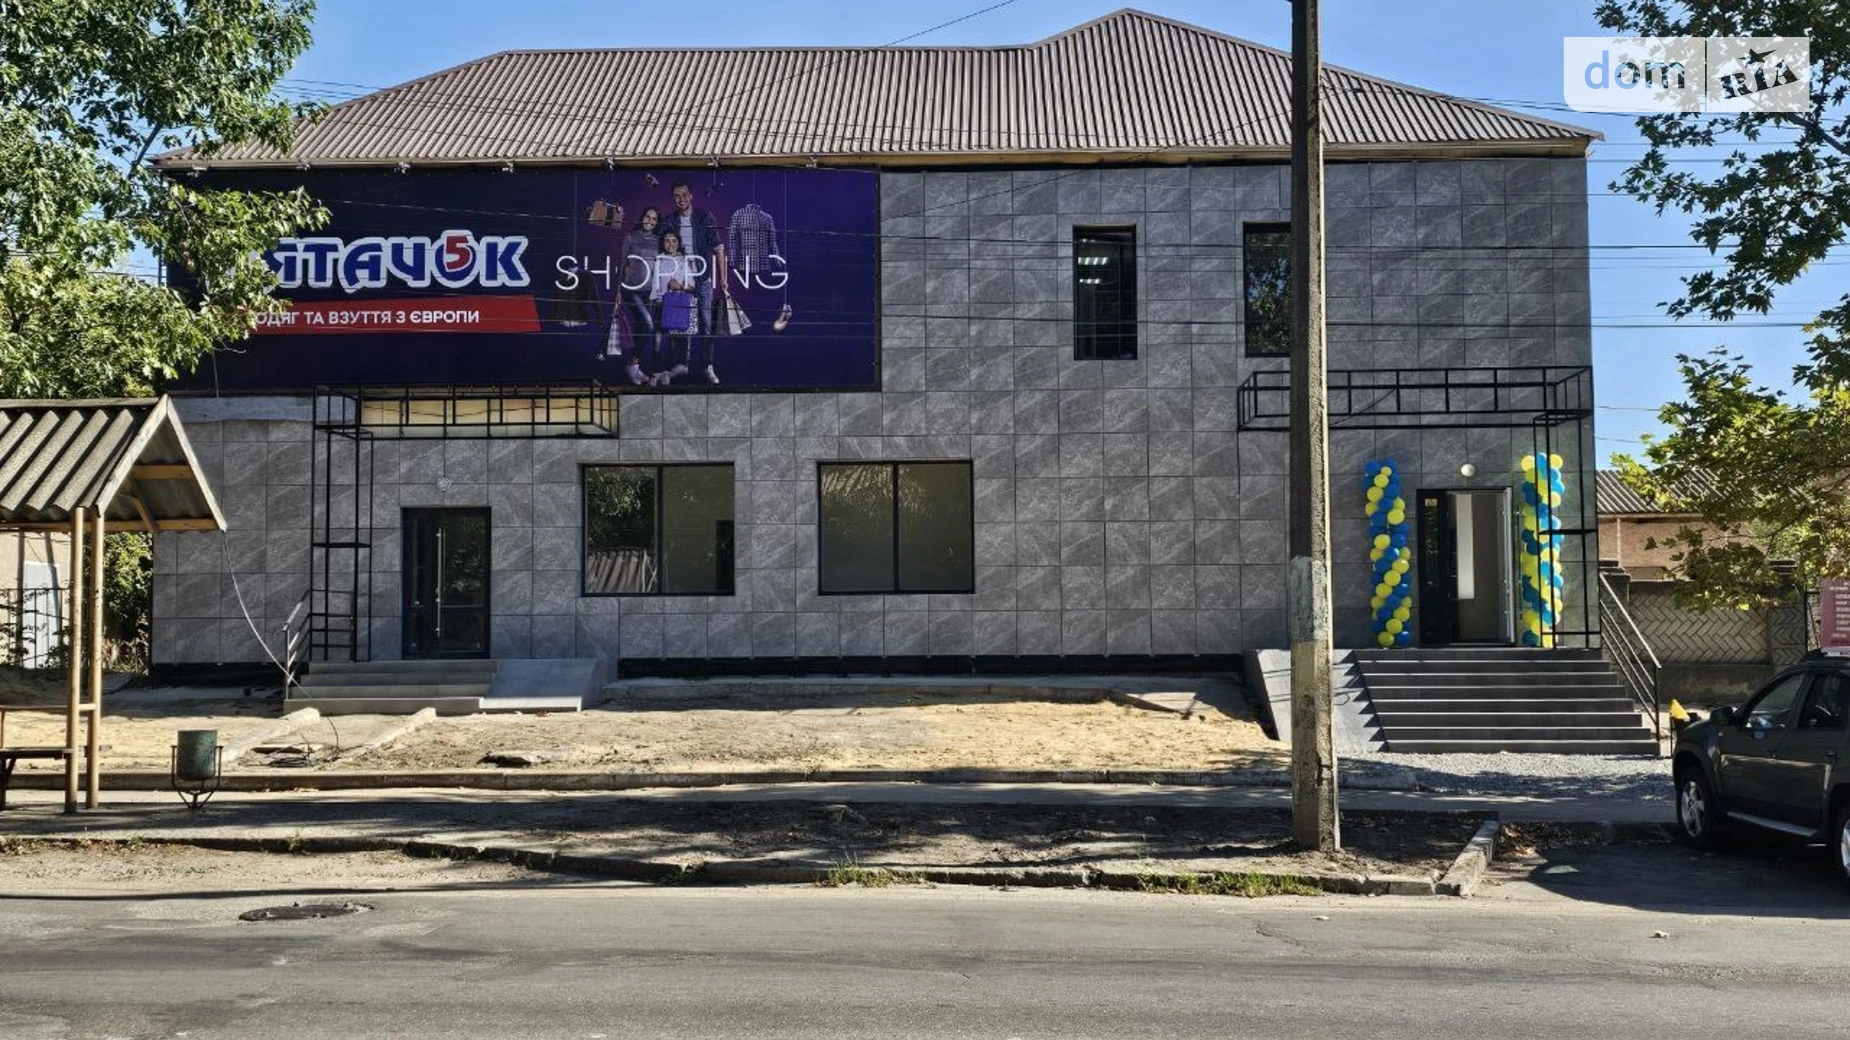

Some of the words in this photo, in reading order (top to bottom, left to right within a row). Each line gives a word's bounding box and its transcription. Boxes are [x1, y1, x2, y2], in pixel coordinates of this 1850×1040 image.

[554, 254, 789, 291] SHOPPING
[255, 312, 300, 326] ОДЯГ
[304, 312, 325, 325] ТА
[328, 311, 392, 325] ВЗУТТЯ
[409, 310, 480, 324] ЄВРОПИ
